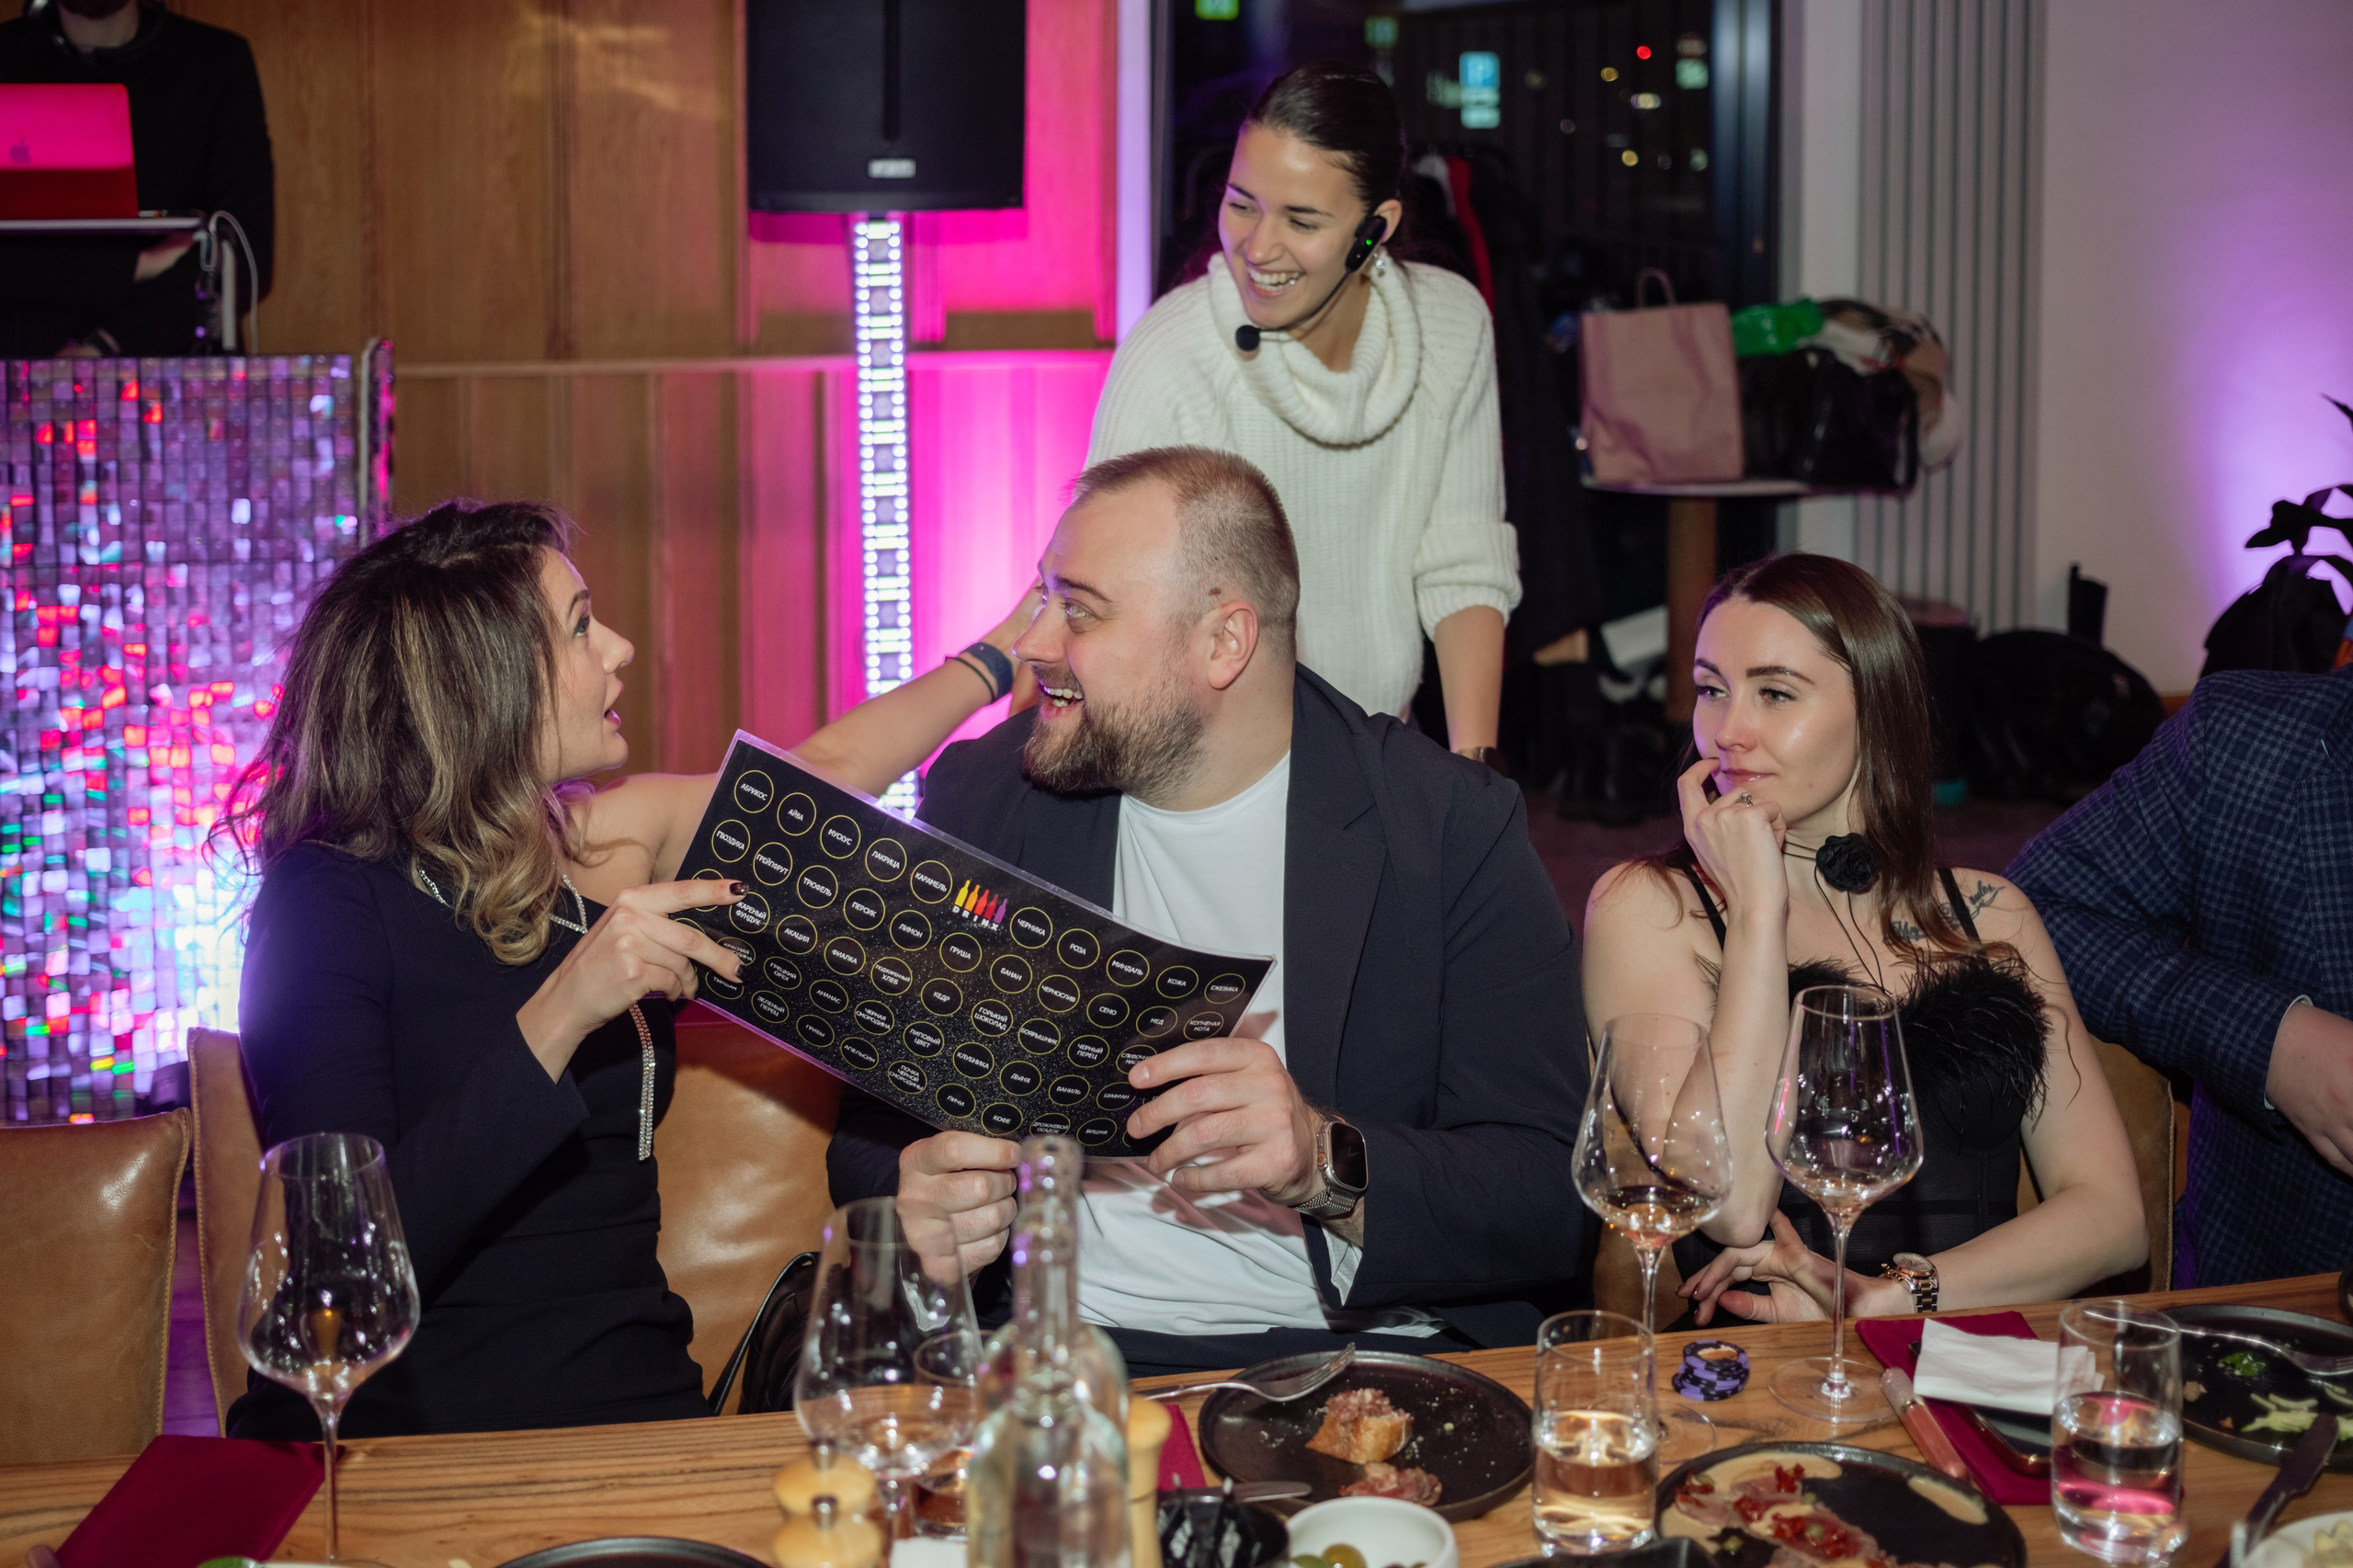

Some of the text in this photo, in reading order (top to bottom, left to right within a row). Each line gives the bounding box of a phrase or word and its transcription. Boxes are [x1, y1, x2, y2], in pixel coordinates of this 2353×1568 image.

[741, 783, 767, 801] АБРИКОС
[788, 809, 804, 822] АЙВА
[716, 830, 745, 850] ГВОЗДИКА
[828, 829, 852, 845] МУСКУС
[756, 854, 790, 875] ГРЕЙПФРУТ
[871, 850, 900, 869] ЛАКРИЦА
[803, 877, 832, 897] ТРЮФЕЛЬ
[915, 872, 948, 892] КАРАМЕЛЬ
[736, 902, 767, 919] ЖАРЕНЫЙ
[851, 901, 877, 917] ПЕРСИК
[736, 910, 760, 926] ФУНДУК
[898, 924, 923, 937] ЛИМОН
[1017, 918, 1046, 936] ЧЕРНИКА
[784, 927, 810, 943] АКАЦИЯ
[831, 949, 858, 964] ФИАЛКА
[949, 946, 972, 960] ГРУША
[1069, 943, 1087, 955] РОЗА
[770, 962, 797, 979] ГРЕЦКИЙ
[876, 964, 910, 982] ПОДЖАРЕННЫЙ
[1000, 968, 1023, 981] БАНАН
[1111, 960, 1143, 975] МИНДАЛЬ
[774, 971, 790, 982] ОРЕХ
[881, 974, 899, 985] ХЛЕБ
[1167, 978, 1187, 986] КОЖА
[817, 990, 842, 1004] АНАНАС
[934, 992, 950, 1002] КЕДР
[1041, 985, 1076, 1003] ЧЕРНОСЛИВ
[760, 1004, 779, 1017] ПЕРЕЦ
[865, 1008, 886, 1020] ЧЕРНАЯ
[979, 1007, 1007, 1022] ГОРЬКИЙ
[1099, 1006, 1118, 1016] СЕНО
[857, 1011, 891, 1029] СМОРОДИНА
[974, 1013, 1007, 1030] ШОКОЛАД
[1150, 1017, 1165, 1026] МЕД
[806, 1025, 825, 1037] ГРИБЫ
[909, 1028, 941, 1045] ЛИПОВЫЙ
[1021, 1028, 1058, 1045] БОЯРЫШНИК
[915, 1039, 931, 1048] ЦВЕТ
[1078, 1043, 1104, 1053] ЧЕРНЫЙ
[845, 1045, 875, 1062] АПЕЛЬСИН
[957, 1052, 990, 1069] КЛУБНИКА
[1077, 1051, 1098, 1060] ПЕРЕЦ
[1011, 1074, 1030, 1084] ДЫНЯ
[1056, 1086, 1082, 1095] ВАНИЛЬ
[947, 1096, 965, 1107] ЛИЧИ
[994, 1115, 1011, 1124] КОФЕ
